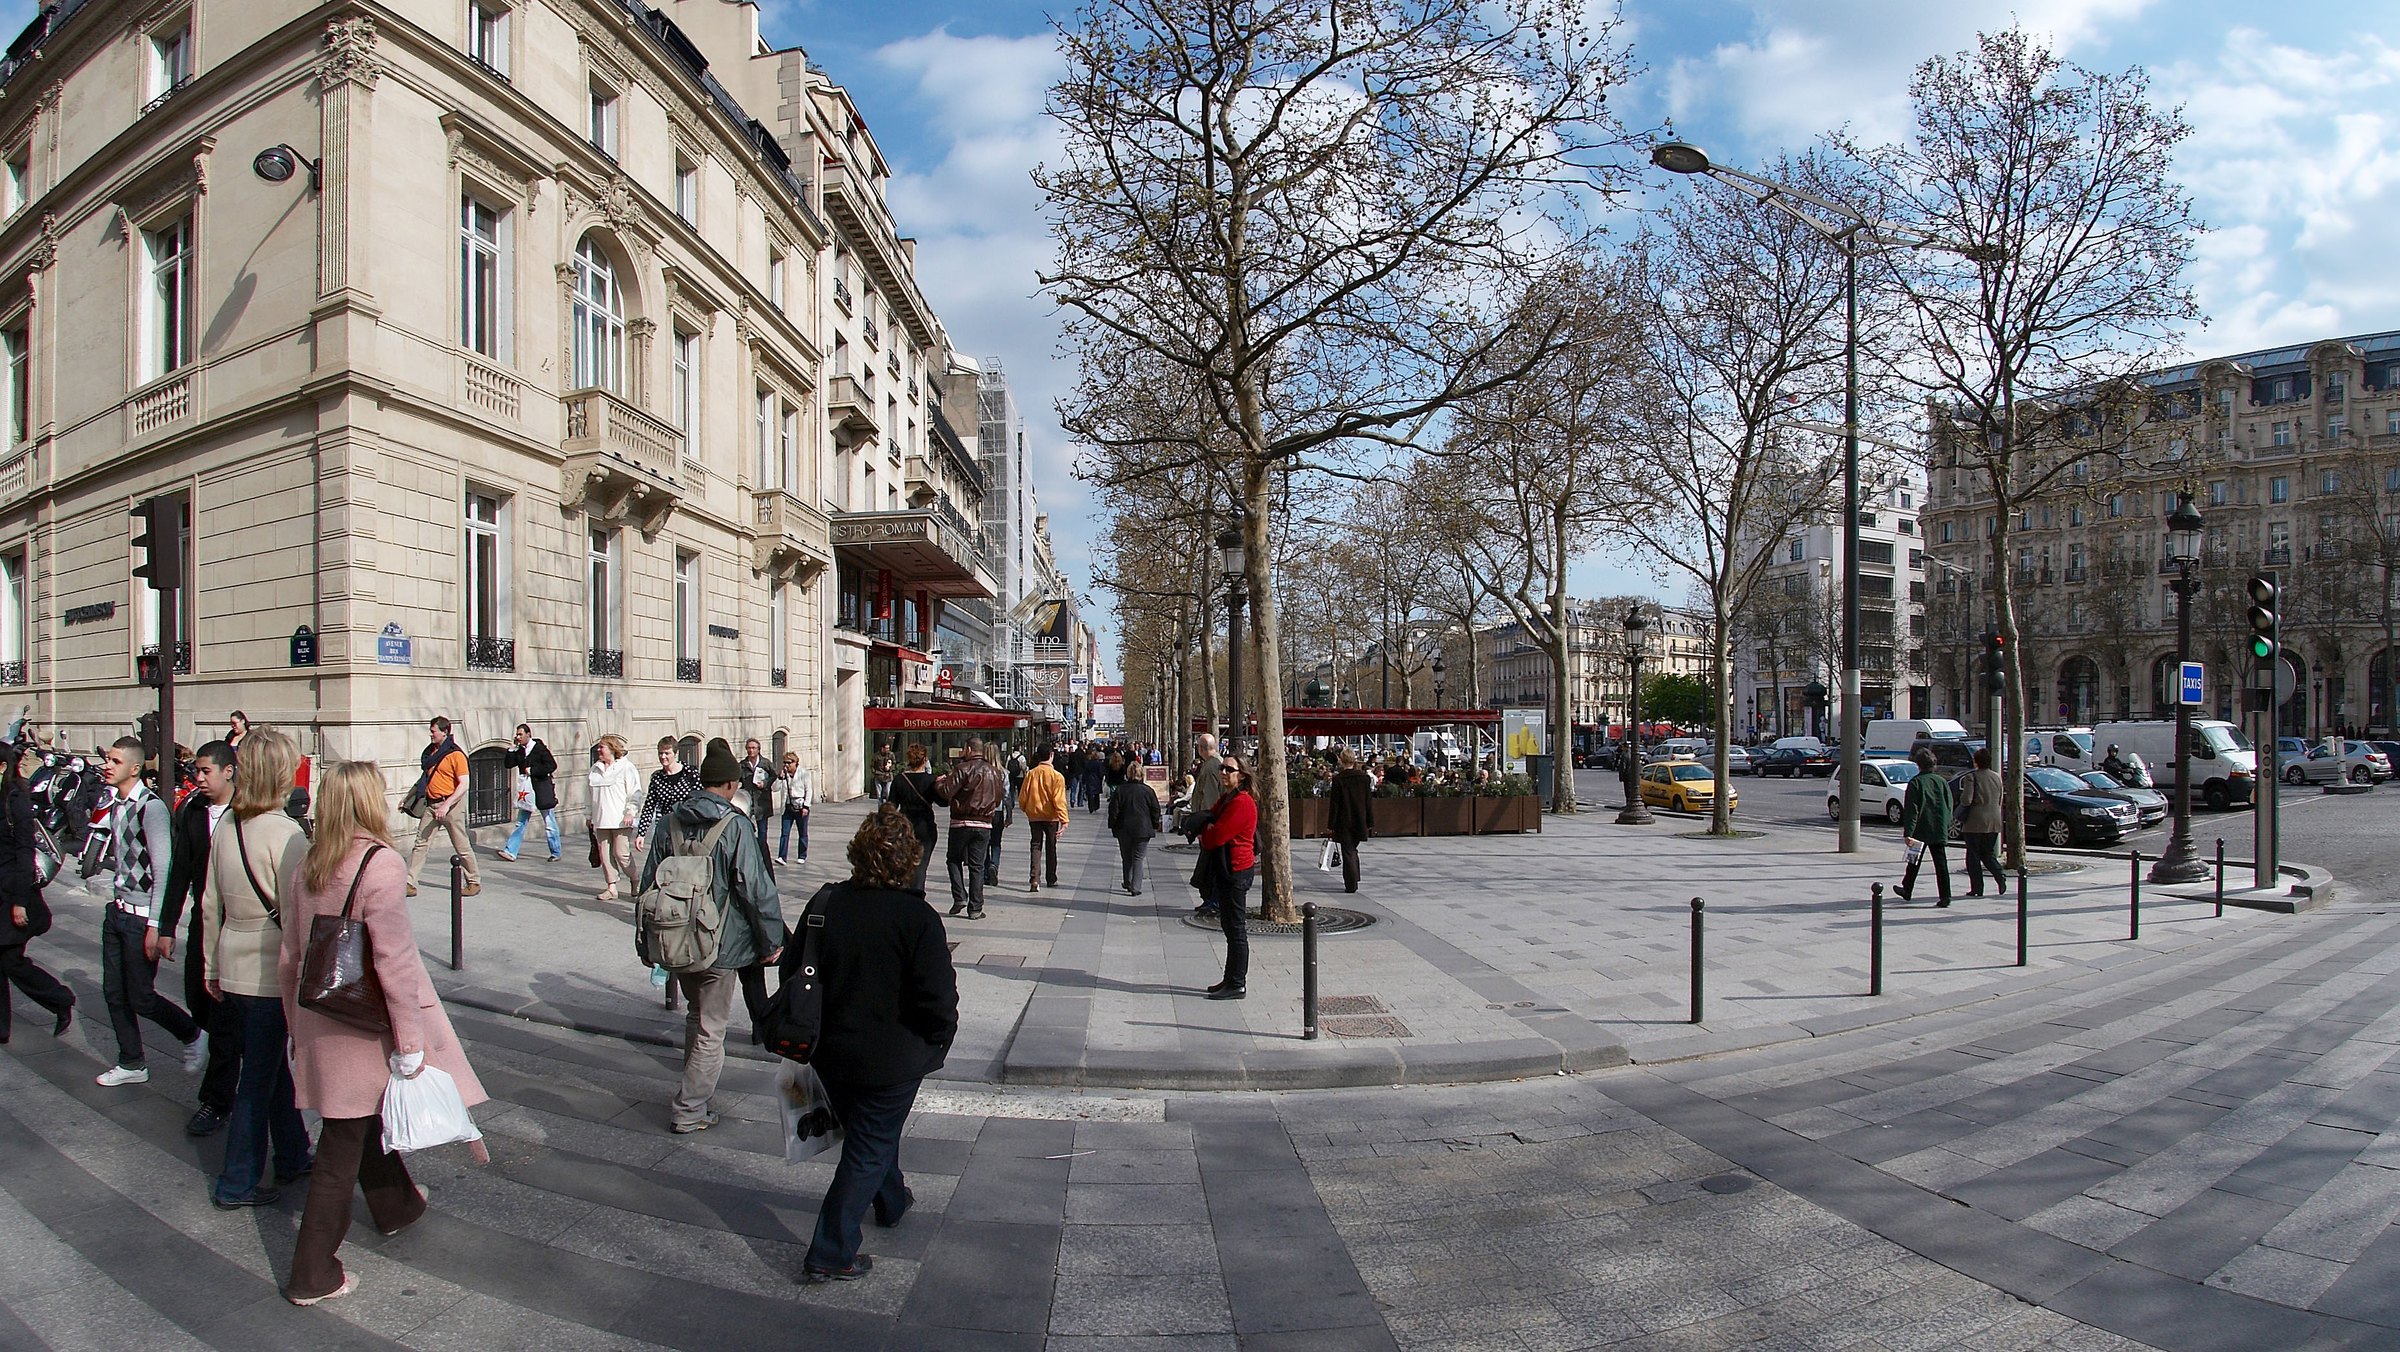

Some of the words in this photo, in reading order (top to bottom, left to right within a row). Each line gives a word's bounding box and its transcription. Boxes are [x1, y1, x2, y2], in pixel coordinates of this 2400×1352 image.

[877, 521, 925, 535] ROMAIN
[1036, 636, 1060, 645] LIDO
[941, 669, 951, 681] Q
[2183, 677, 2202, 690] TAXIS
[904, 718, 932, 728] BISTRO
[934, 719, 967, 728] ROMAIN
